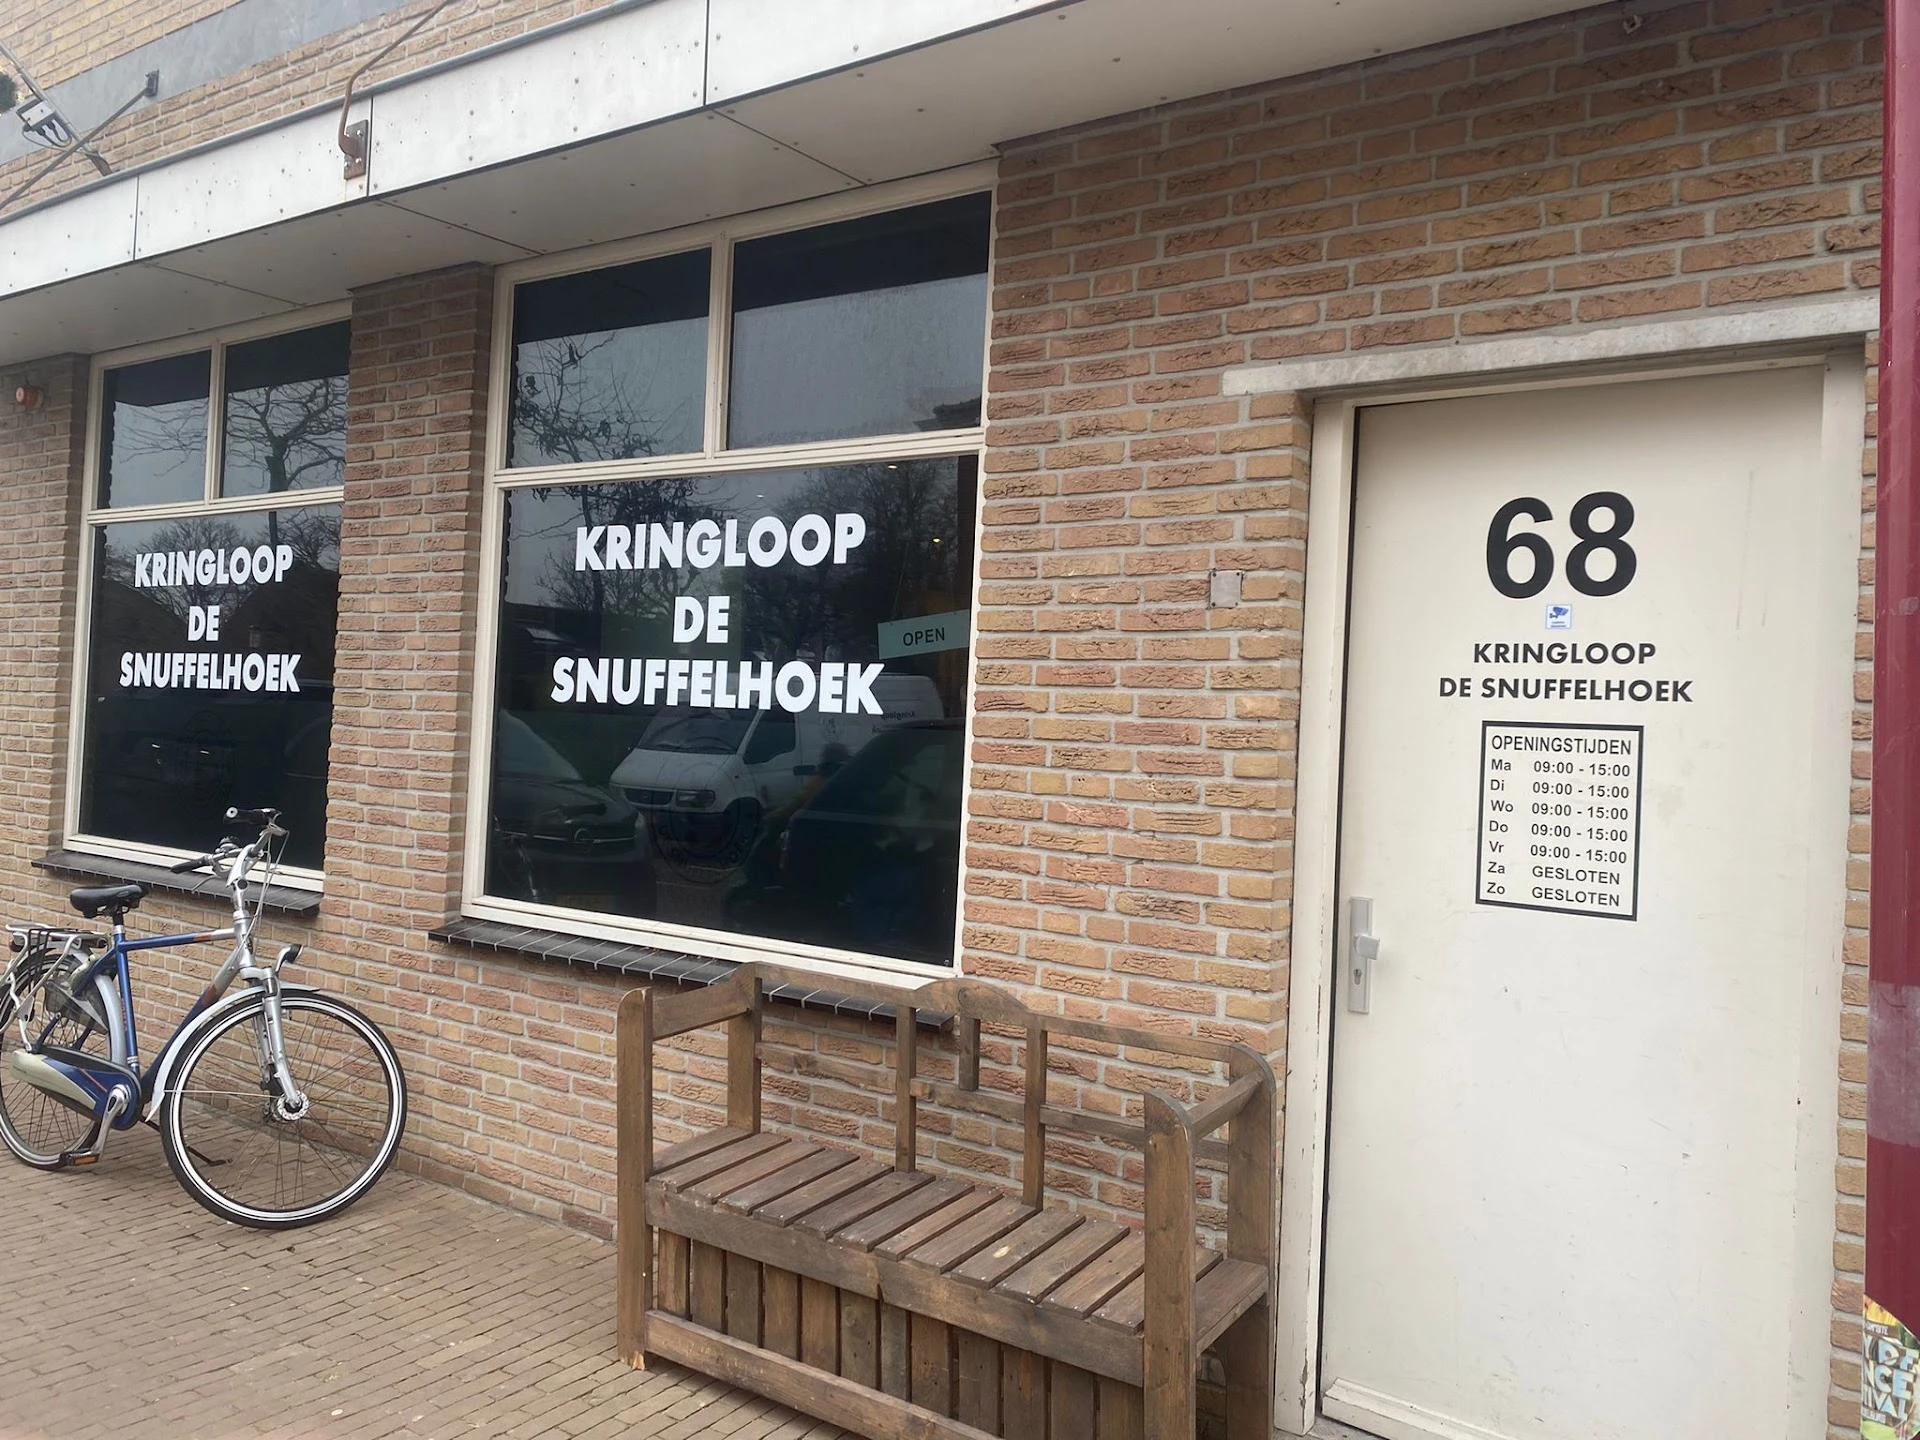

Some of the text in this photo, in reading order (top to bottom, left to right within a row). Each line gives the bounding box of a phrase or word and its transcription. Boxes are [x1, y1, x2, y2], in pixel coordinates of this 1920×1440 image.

[576, 514, 865, 570] KRINGLOOP
[1487, 492, 1636, 599] 68
[135, 545, 292, 587] KRINGLOOP
[188, 606, 219, 640] DE
[674, 596, 729, 643] DE
[903, 628, 944, 646] OPEN
[1474, 643, 1655, 664] KRINGLOOP
[120, 652, 300, 692] SNUFFELHOEK
[551, 657, 884, 714] SNUFFELHOEK
[1440, 678, 1692, 702] DE SNUFFELHOEK
[1492, 735, 1631, 754] OPENINGSTIJDEN
[1492, 759, 1511, 770] Ma
[1534, 761, 1573, 773] 09:00
[1590, 764, 1629, 776] 15:00
[1491, 780, 1504, 790] Di
[1533, 782, 1572, 795] 09:00
[1589, 785, 1628, 798] 15:00
[1491, 800, 1513, 812] Wo
[1532, 803, 1571, 816] 09:00
[1588, 807, 1628, 820] 15:00
[1490, 821, 1508, 832] Do
[1532, 824, 1570, 837] 09:00
[1588, 828, 1627, 841] 15:00
[1489, 841, 1504, 852] Vr
[1531, 845, 1569, 858] 09:00
[1586, 849, 1626, 863] 15:00
[1488, 862, 1619, 884] Za GESLOTEN
[1487, 882, 1620, 906] Zo GESLOTEN
